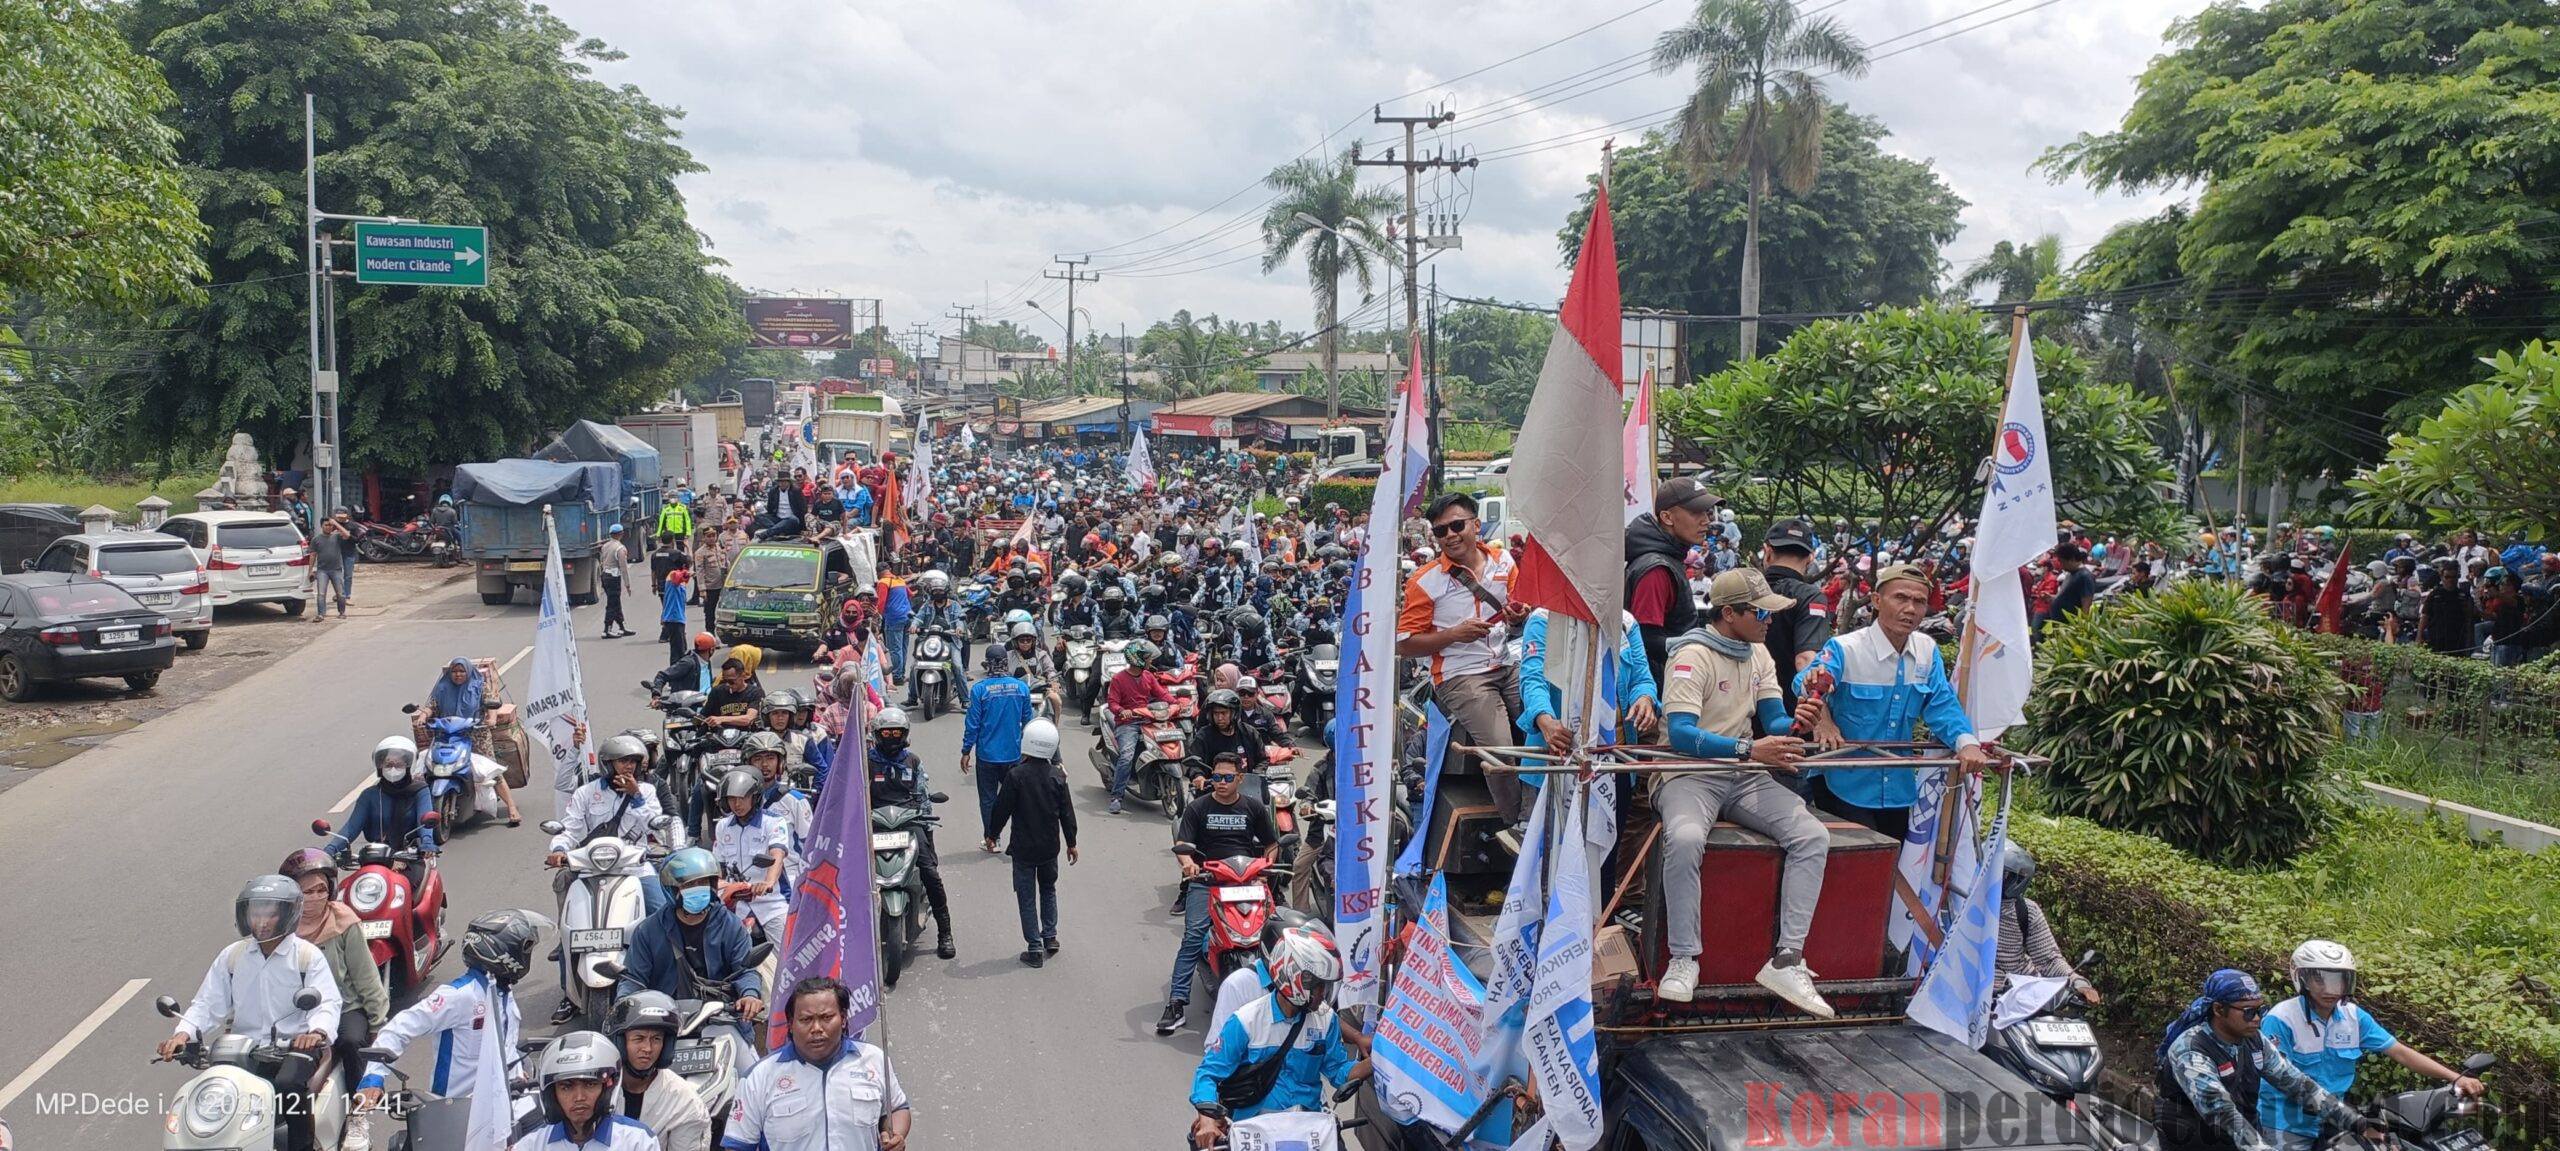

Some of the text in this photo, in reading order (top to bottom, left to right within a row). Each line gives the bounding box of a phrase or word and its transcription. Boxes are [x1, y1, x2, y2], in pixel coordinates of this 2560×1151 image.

[366, 235, 454, 249] Kawasan Industri
[366, 258, 451, 272] Modern Cikande
[1207, 816, 1246, 824] GARTEKS
[691, 1050, 712, 1062] ABD
[681, 1063, 711, 1072] 07-27
[1532, 1033, 1563, 1098] BANTEN
[1556, 1050, 1598, 1129] NASIONAL
